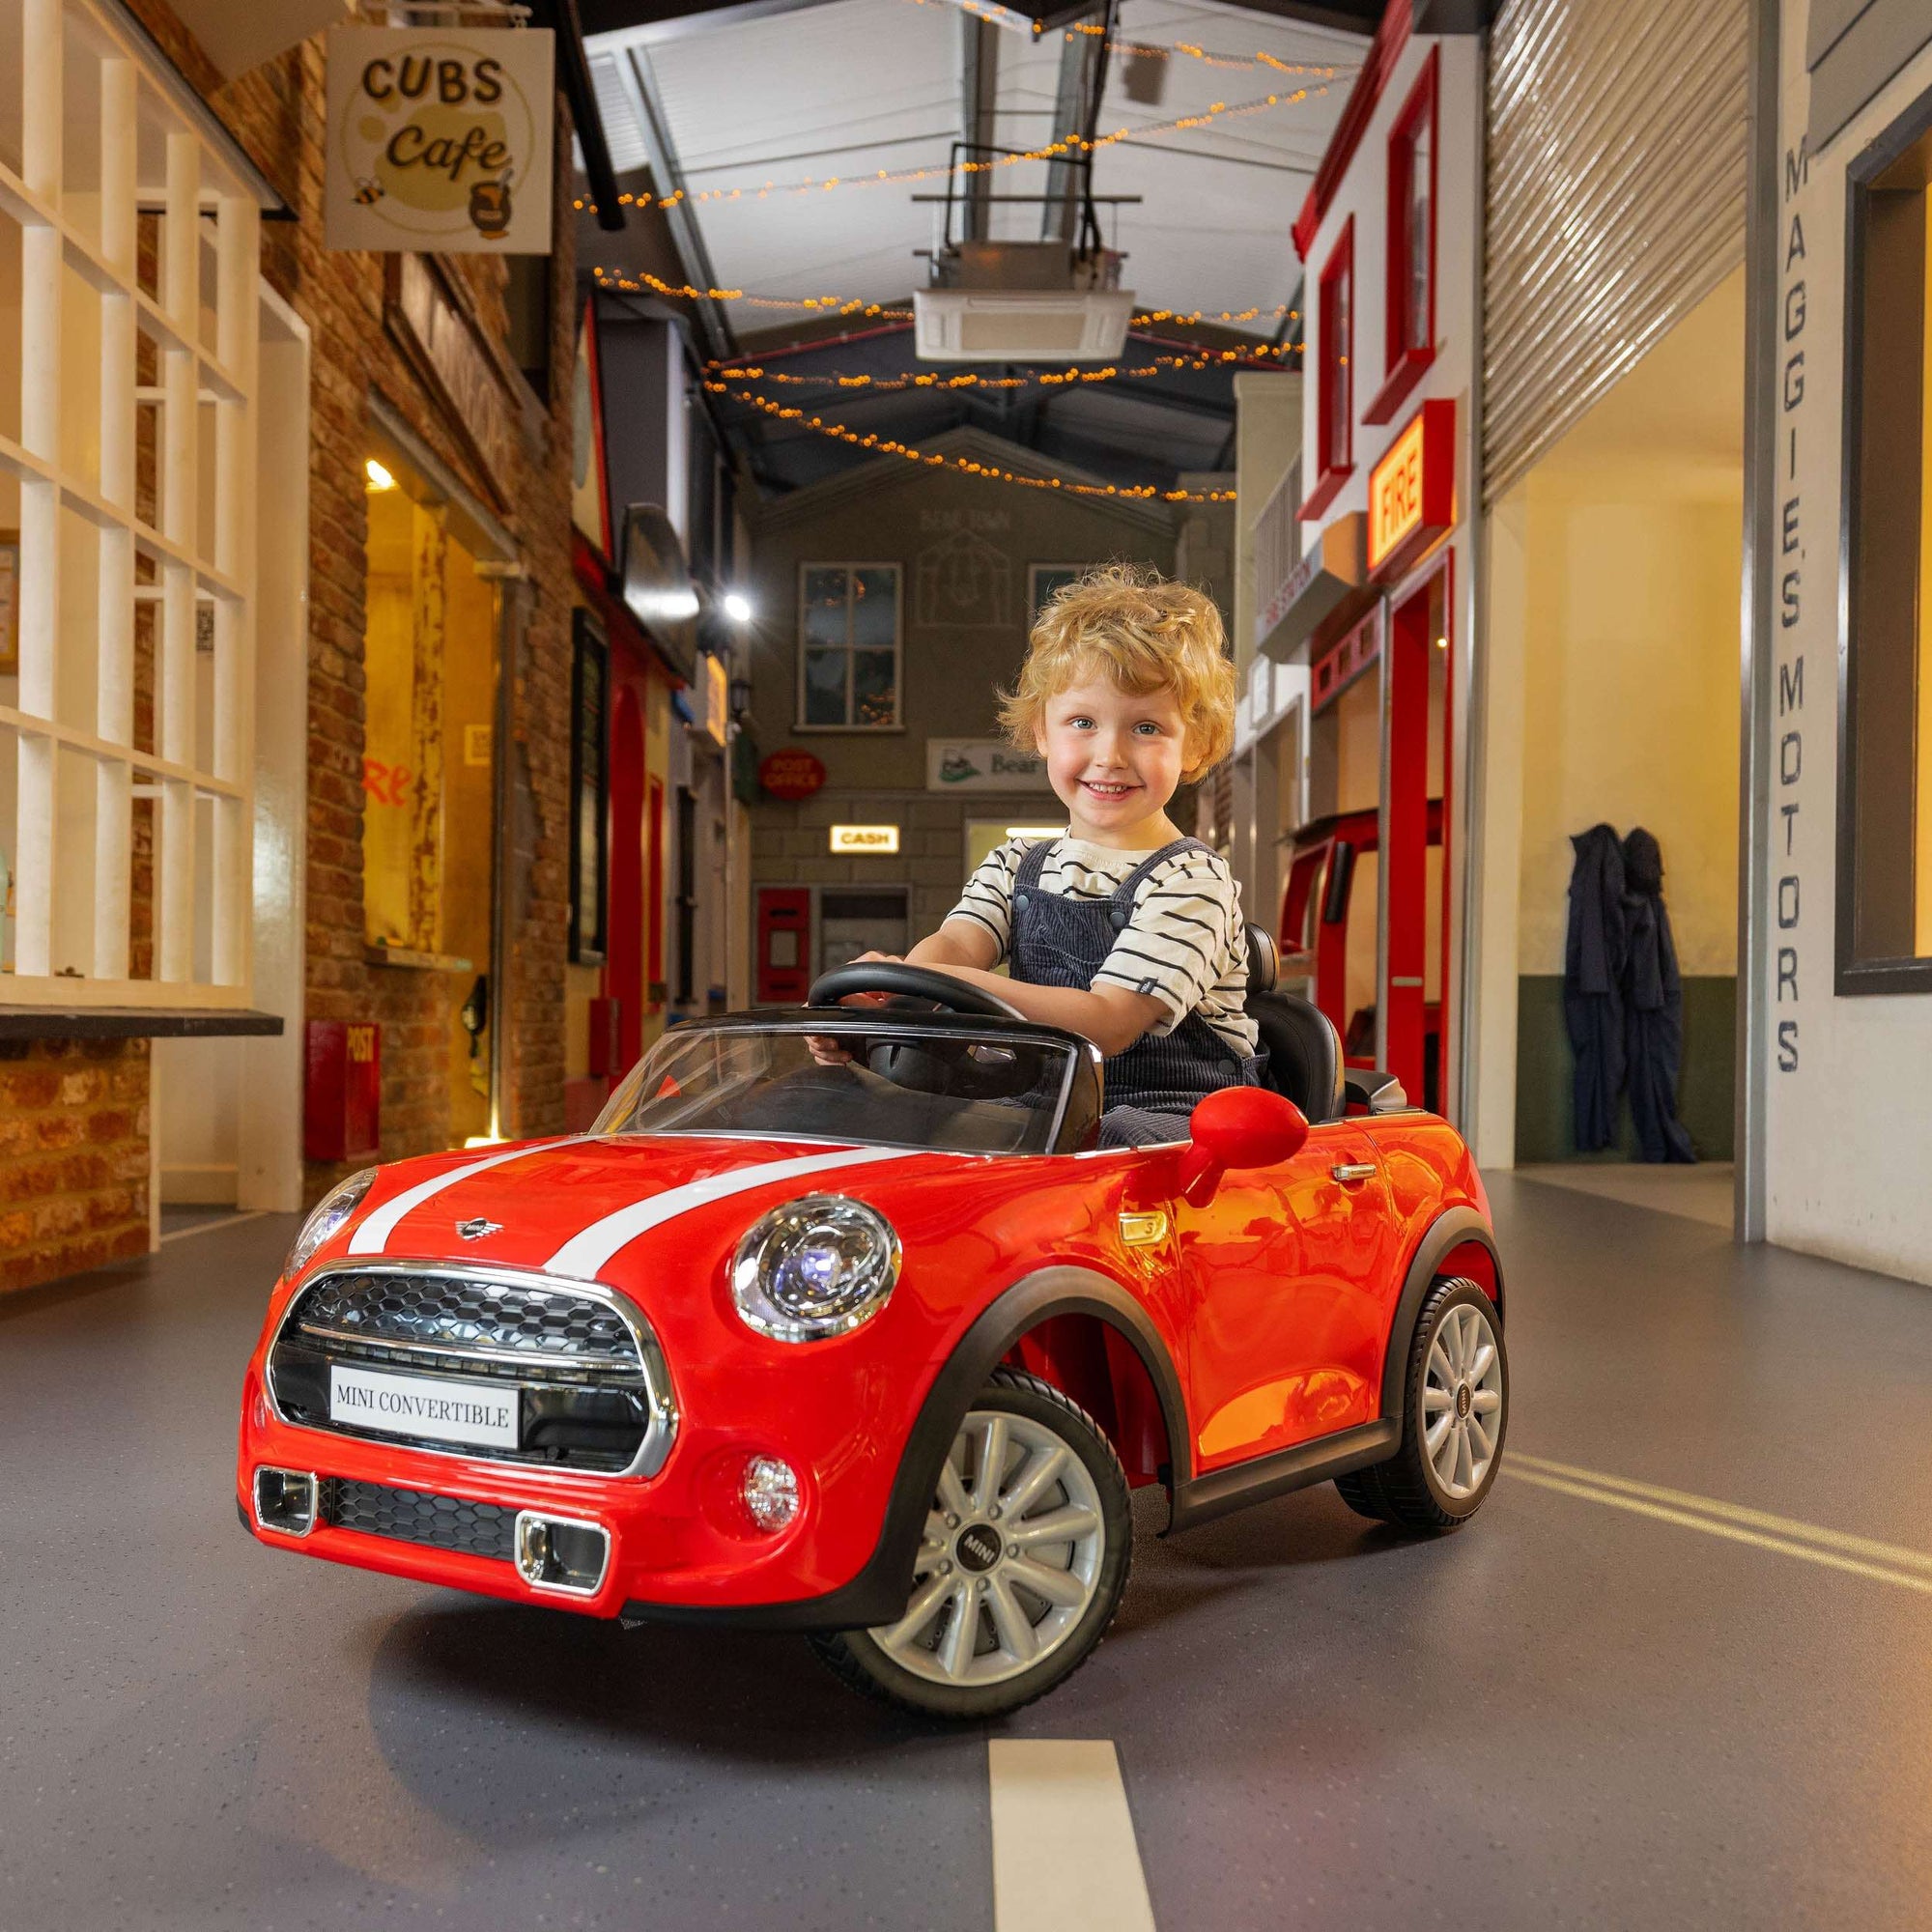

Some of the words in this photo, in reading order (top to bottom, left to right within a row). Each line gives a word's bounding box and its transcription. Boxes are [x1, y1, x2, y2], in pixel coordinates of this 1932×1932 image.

[363, 55, 502, 103] CUBS
[387, 125, 513, 182] Cafe
[1381, 448, 1417, 544] FIRE
[840, 832, 890, 845] CASH
[1777, 656, 1804, 1073] MOTORS
[337, 1383, 375, 1409] MINI
[379, 1391, 509, 1429] CONVERTIBLE
[964, 1534, 995, 1564] MINI
